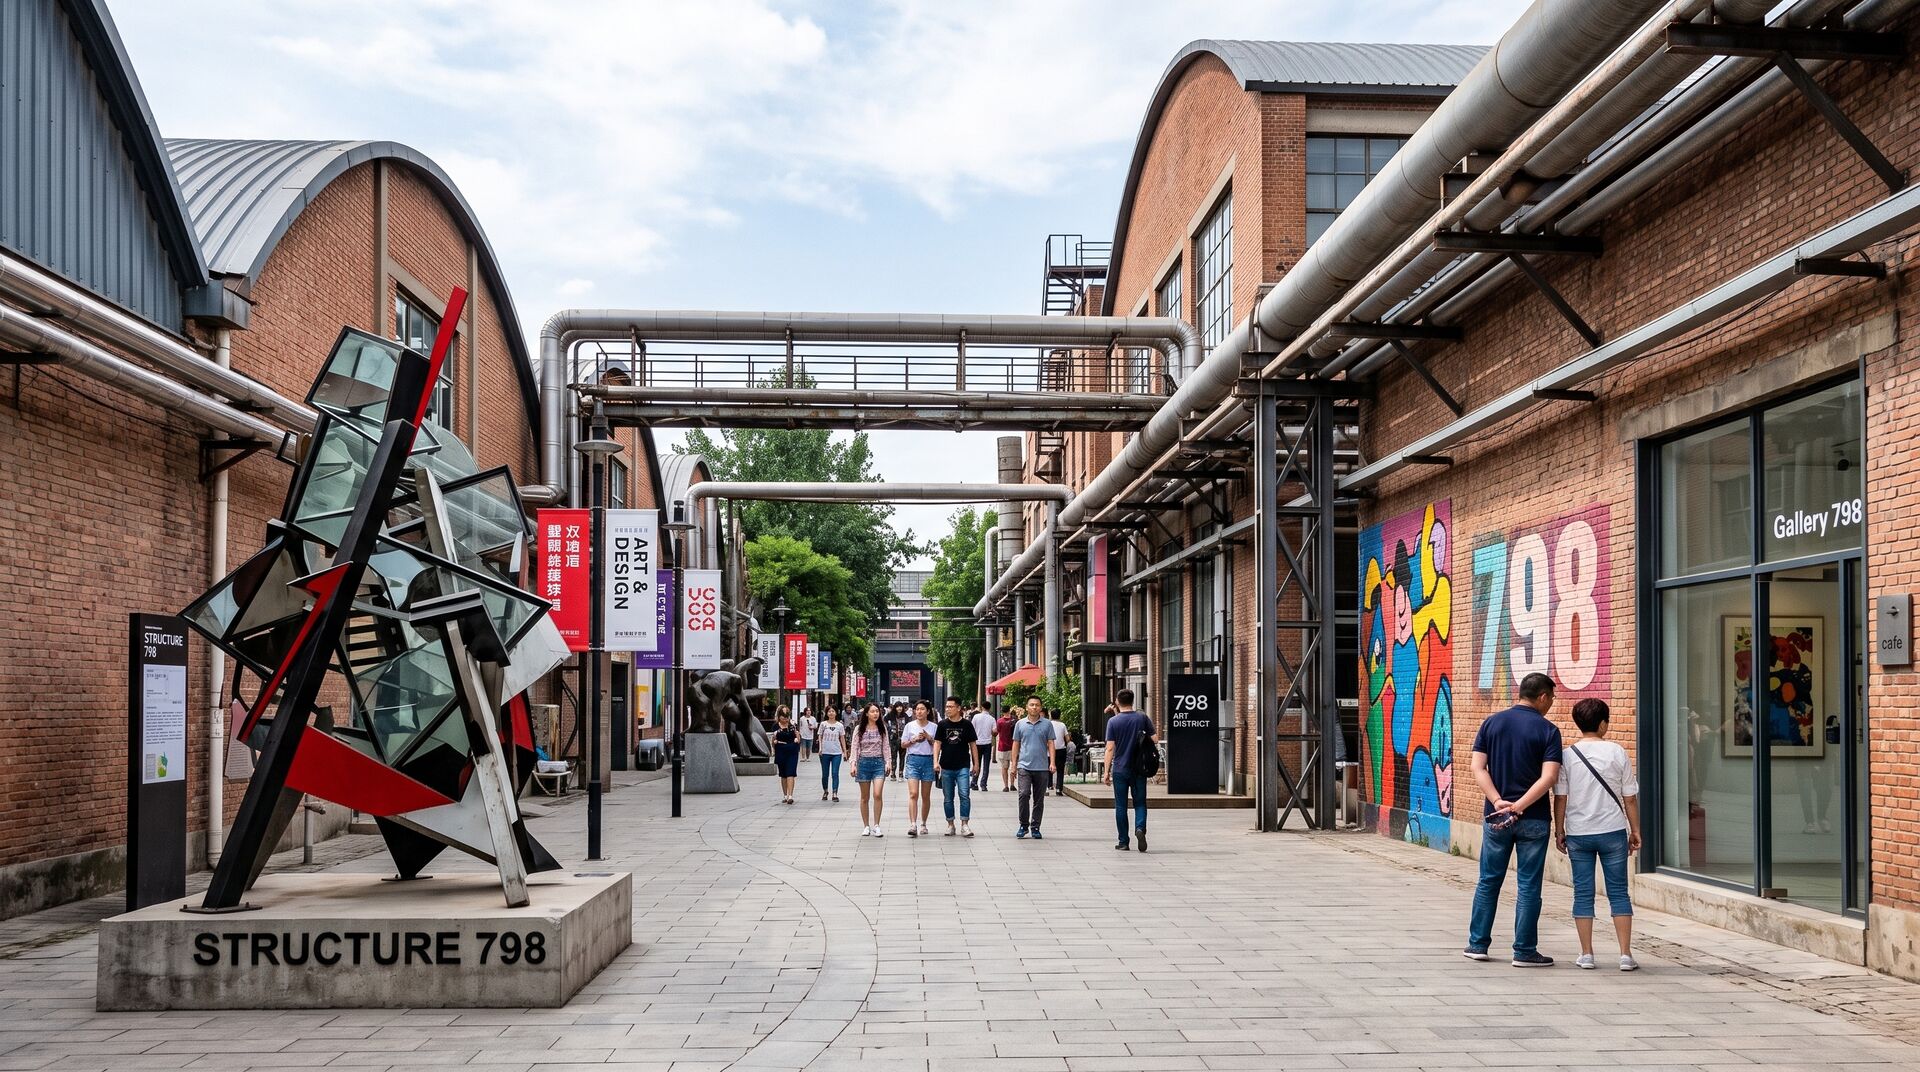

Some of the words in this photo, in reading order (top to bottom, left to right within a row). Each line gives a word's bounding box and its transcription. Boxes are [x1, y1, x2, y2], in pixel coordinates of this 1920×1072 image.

[1774, 510, 1828, 539] Gallery
[1831, 498, 1862, 528] 798
[633, 537, 648, 575] ART
[614, 537, 629, 610] DESIGN
[633, 581, 648, 593] &
[1474, 520, 1600, 690] 798
[144, 632, 184, 647] STRUCTURE
[1881, 635, 1903, 650] cafe
[143, 645, 157, 658] 798
[1173, 694, 1209, 711] 798
[1173, 712, 1189, 720] ART
[1173, 720, 1211, 728] DISTRICT
[193, 931, 462, 967] STRUCTURE
[475, 931, 547, 966] 798
